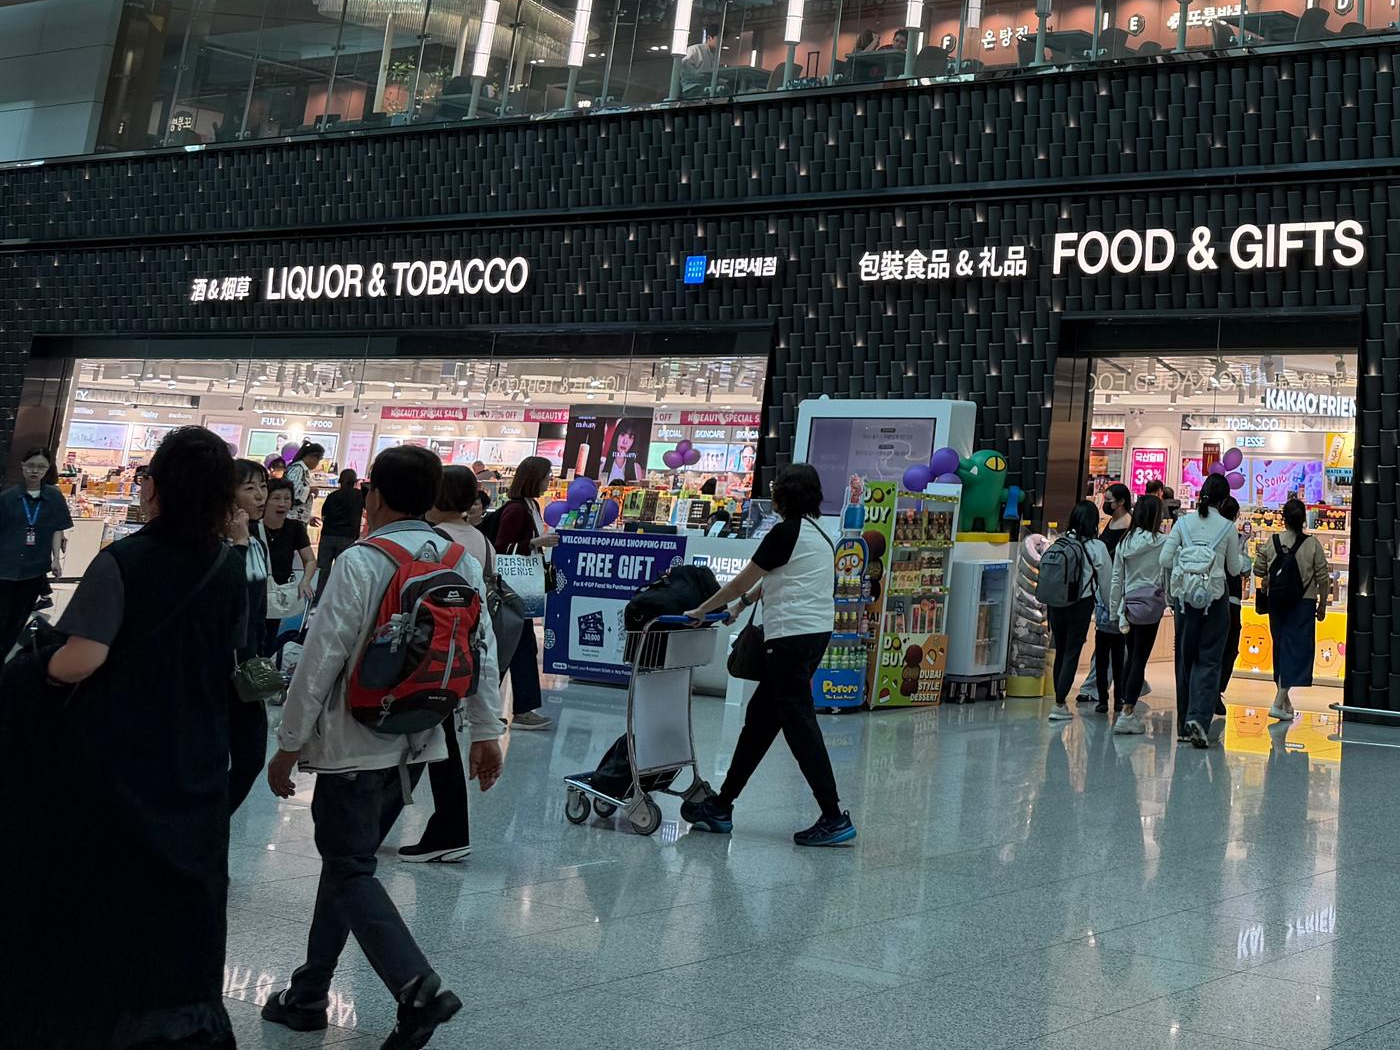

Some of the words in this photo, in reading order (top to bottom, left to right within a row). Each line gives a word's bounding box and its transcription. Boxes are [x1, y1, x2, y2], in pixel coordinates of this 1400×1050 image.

[1129, 16, 1138, 30] E
[942, 36, 951, 50] F
[1053, 229, 1176, 275] FOOD
[1187, 226, 1217, 270] &
[1230, 220, 1365, 269] GIFTS
[706, 256, 777, 279] 시티면세점
[956, 250, 974, 276] &
[979, 246, 1027, 277] 礼品
[266, 264, 363, 301] LIQUOR
[368, 262, 386, 298] &
[392, 257, 530, 297] TOBACCO
[207, 280, 219, 300] &
[1266, 387, 1317, 414] KAKAO
[562, 535, 591, 545] WELCOME
[591, 537, 610, 546] K-POP
[611, 538, 626, 547] FANS
[627, 539, 659, 548] SHOPPING
[660, 540, 677, 550] FESTA
[576, 552, 614, 578] FREE
[617, 555, 655, 581] GIFT
[882, 652, 905, 667] BUY
[919, 669, 942, 679] DUBAI
[822, 680, 858, 694] Pororo
[918, 681, 940, 691] STYLE
[910, 693, 939, 702] DESSERT
